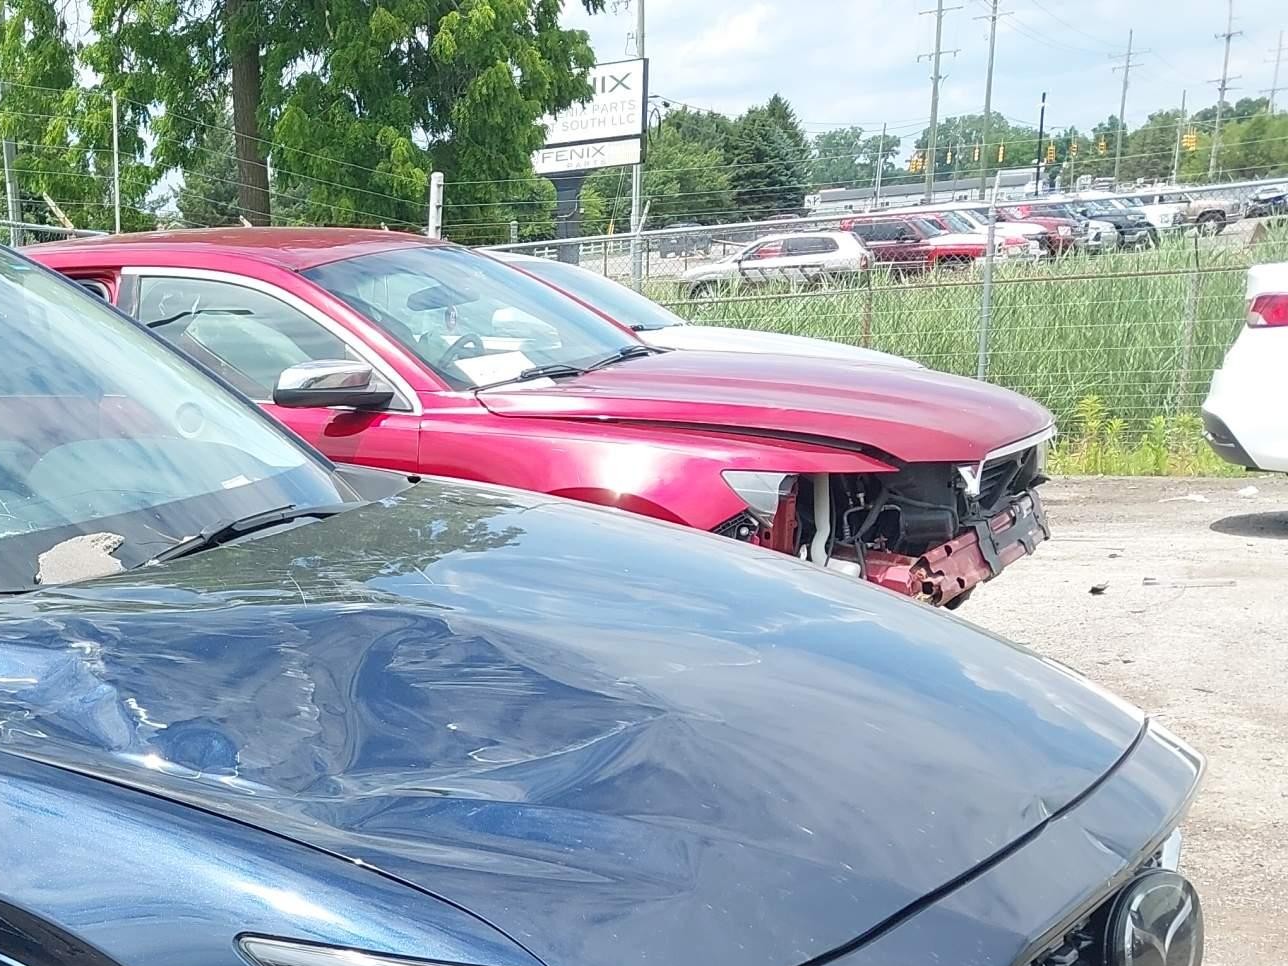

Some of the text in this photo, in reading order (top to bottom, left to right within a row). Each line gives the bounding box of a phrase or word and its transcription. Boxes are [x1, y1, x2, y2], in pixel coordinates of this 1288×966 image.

[592, 99, 636, 114] PARTS
[561, 118, 606, 132] SOUTH
[611, 113, 635, 126] LLC
[542, 145, 605, 163] FENIX
